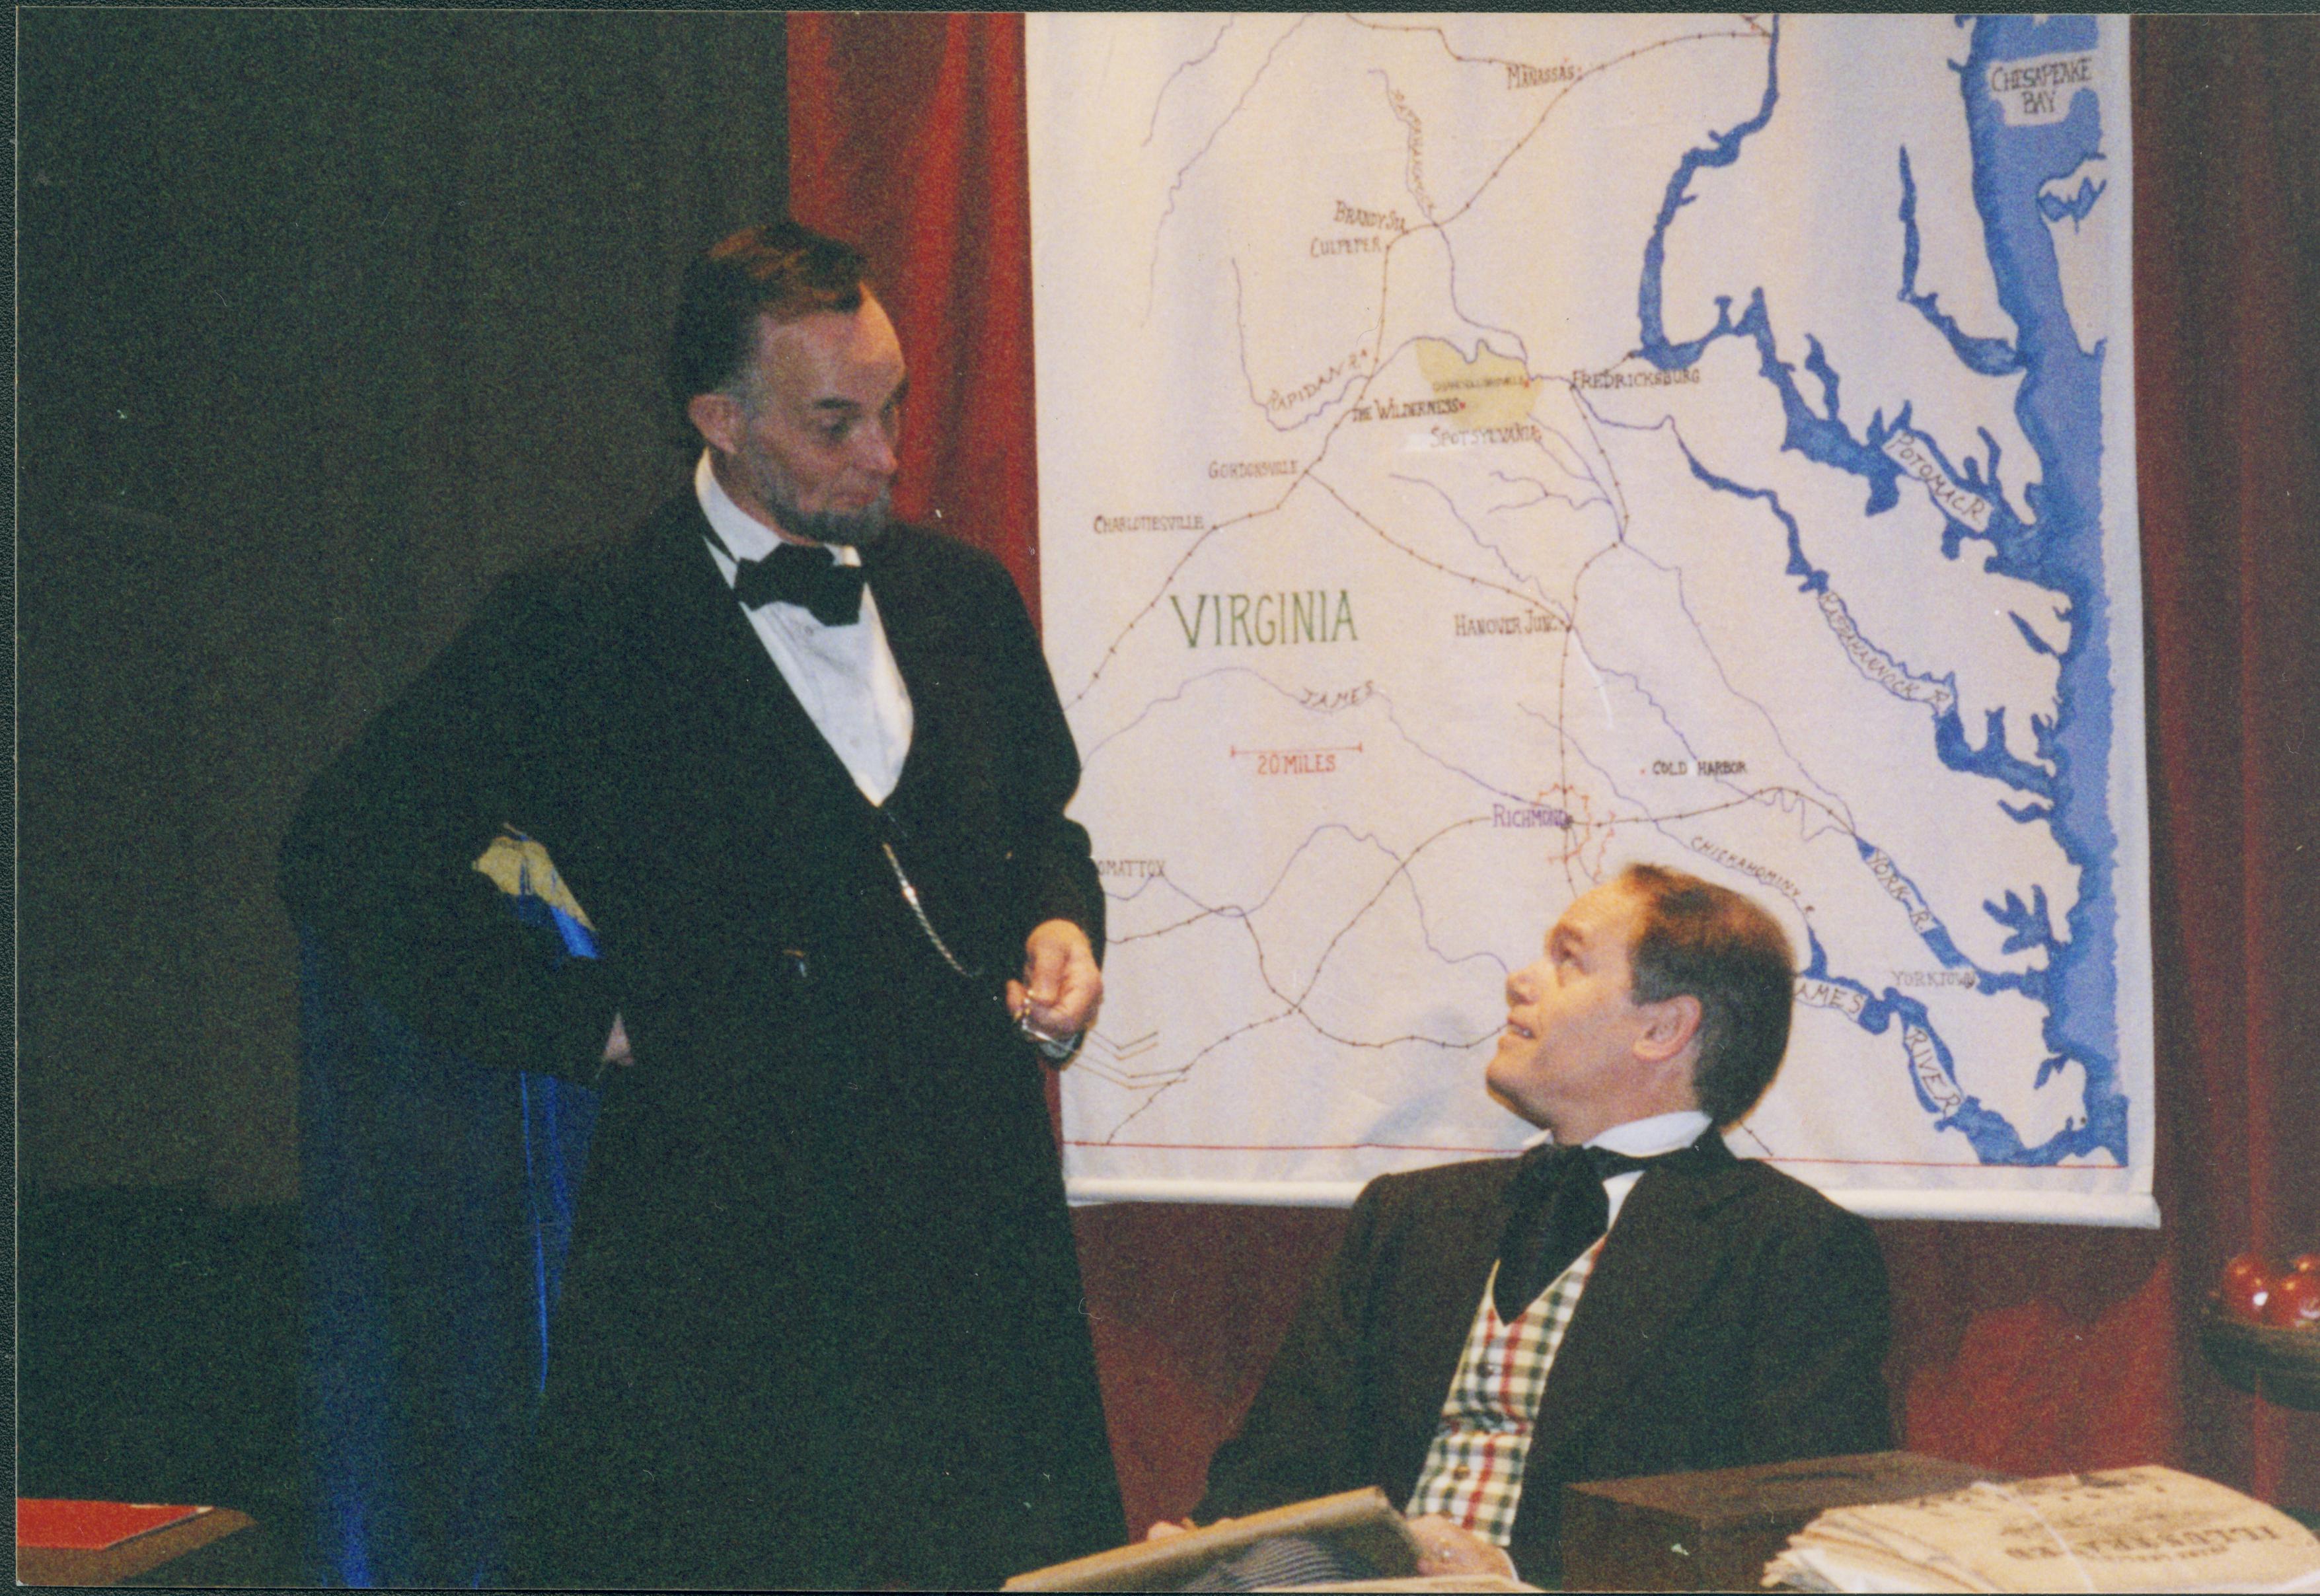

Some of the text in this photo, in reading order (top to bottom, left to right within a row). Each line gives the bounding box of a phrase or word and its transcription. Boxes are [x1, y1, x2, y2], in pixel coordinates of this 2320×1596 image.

[1992, 57, 2093, 92] CHESAPEAKE
[2021, 90, 2056, 115] BAY
[1170, 588, 1359, 649] VIRGINIA
[1299, 679, 1375, 709] JAMES
[1257, 752, 1337, 776] 20 MILES
[1653, 760, 1747, 776] COLD HARBOR
[1492, 803, 1569, 829] RICHMOND
[1795, 982, 1962, 1119] AMES RIVER
